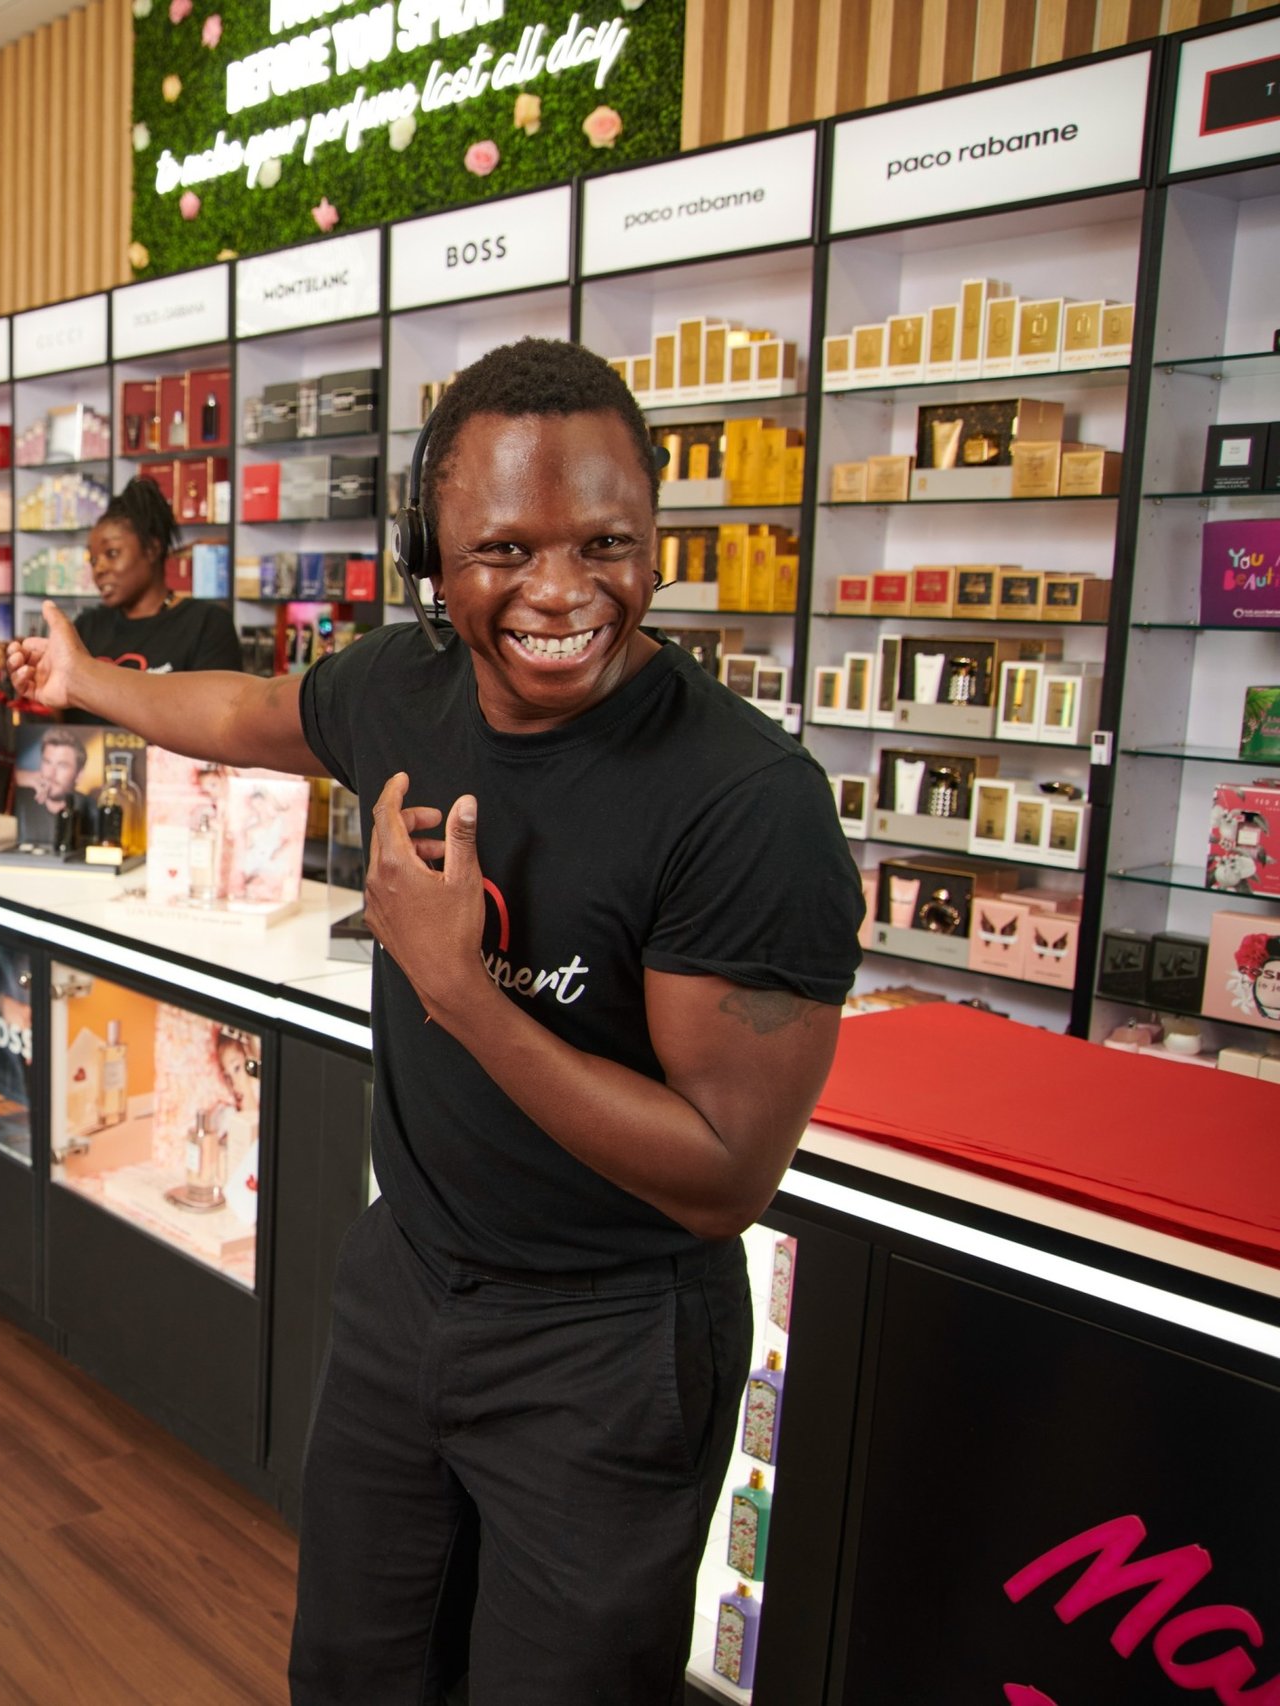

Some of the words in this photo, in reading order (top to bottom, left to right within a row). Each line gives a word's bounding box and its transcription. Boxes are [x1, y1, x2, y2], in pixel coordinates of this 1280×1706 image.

[331, 3, 394, 76] YOU
[303, 82, 420, 165] perfume
[421, 42, 494, 112] last
[491, 23, 546, 91] all
[546, 13, 630, 90] day
[887, 150, 951, 180] paco
[957, 122, 1079, 163] rabanne
[623, 208, 673, 231] paco
[677, 187, 765, 218] rabanne
[446, 235, 508, 268] BOSS
